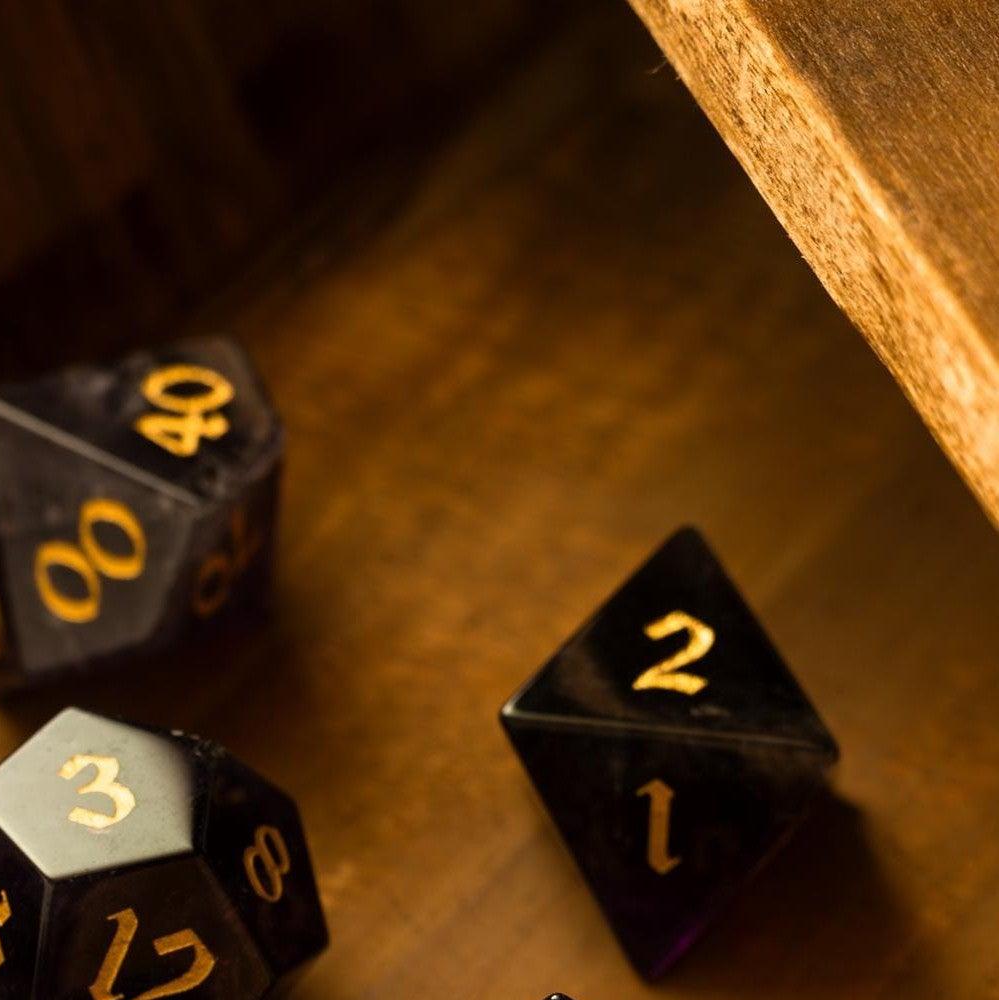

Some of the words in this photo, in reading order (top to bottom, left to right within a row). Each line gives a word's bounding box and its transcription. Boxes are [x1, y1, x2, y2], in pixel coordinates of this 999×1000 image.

[134, 364, 234, 456] 40
[35, 499, 146, 623] 00
[631, 609, 716, 696] 2
[58, 754, 136, 830] 3
[636, 778, 682, 876] 1
[243, 825, 290, 903] 8
